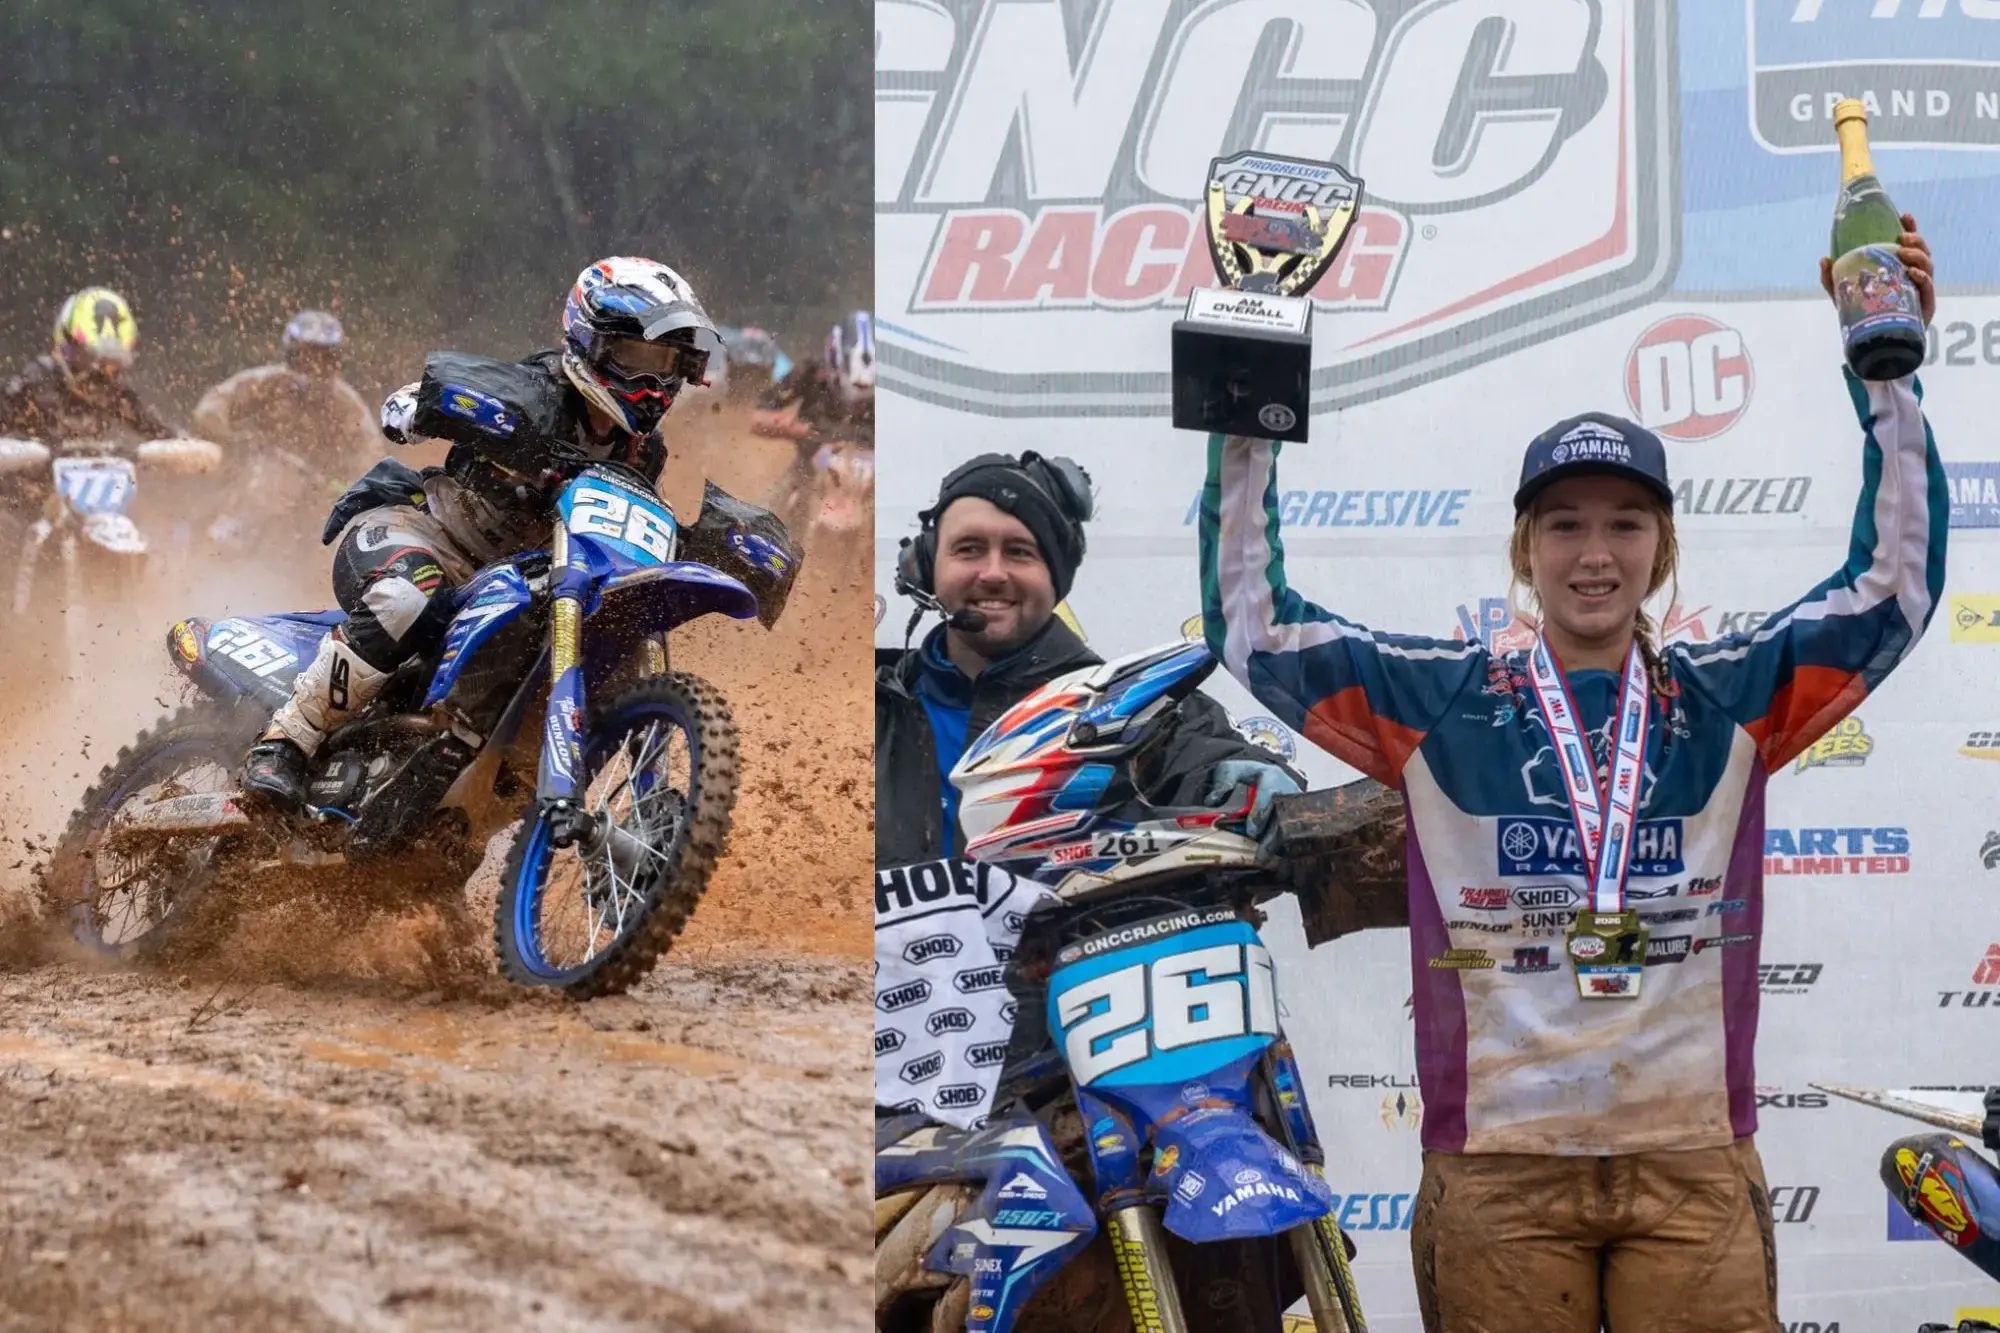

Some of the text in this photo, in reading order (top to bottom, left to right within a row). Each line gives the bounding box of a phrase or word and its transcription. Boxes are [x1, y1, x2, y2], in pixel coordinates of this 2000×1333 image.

[1242, 159, 1333, 180] PROGRESSIVE
[1220, 170, 1353, 206] GNCC
[924, 210, 1402, 302] RACIG
[1213, 303, 1284, 319] OVERALL
[1238, 298, 1265, 308] AM
[1638, 329, 1747, 429] DC
[1569, 440, 1632, 460] YAMAHA
[1098, 831, 1160, 857] 261
[1764, 828, 1910, 856] ARTS
[1517, 890, 1570, 906] SHOEI
[1450, 920, 1513, 933] DUNLOP
[910, 938, 955, 962] SHOEI
[882, 983, 927, 1009] SHOEI
[931, 1012, 968, 1033] SHOEI
[939, 1087, 978, 1106] SHOEI
[1211, 1183, 1300, 1218] YAMAHA
[992, 1209, 1068, 1227] 250FX
